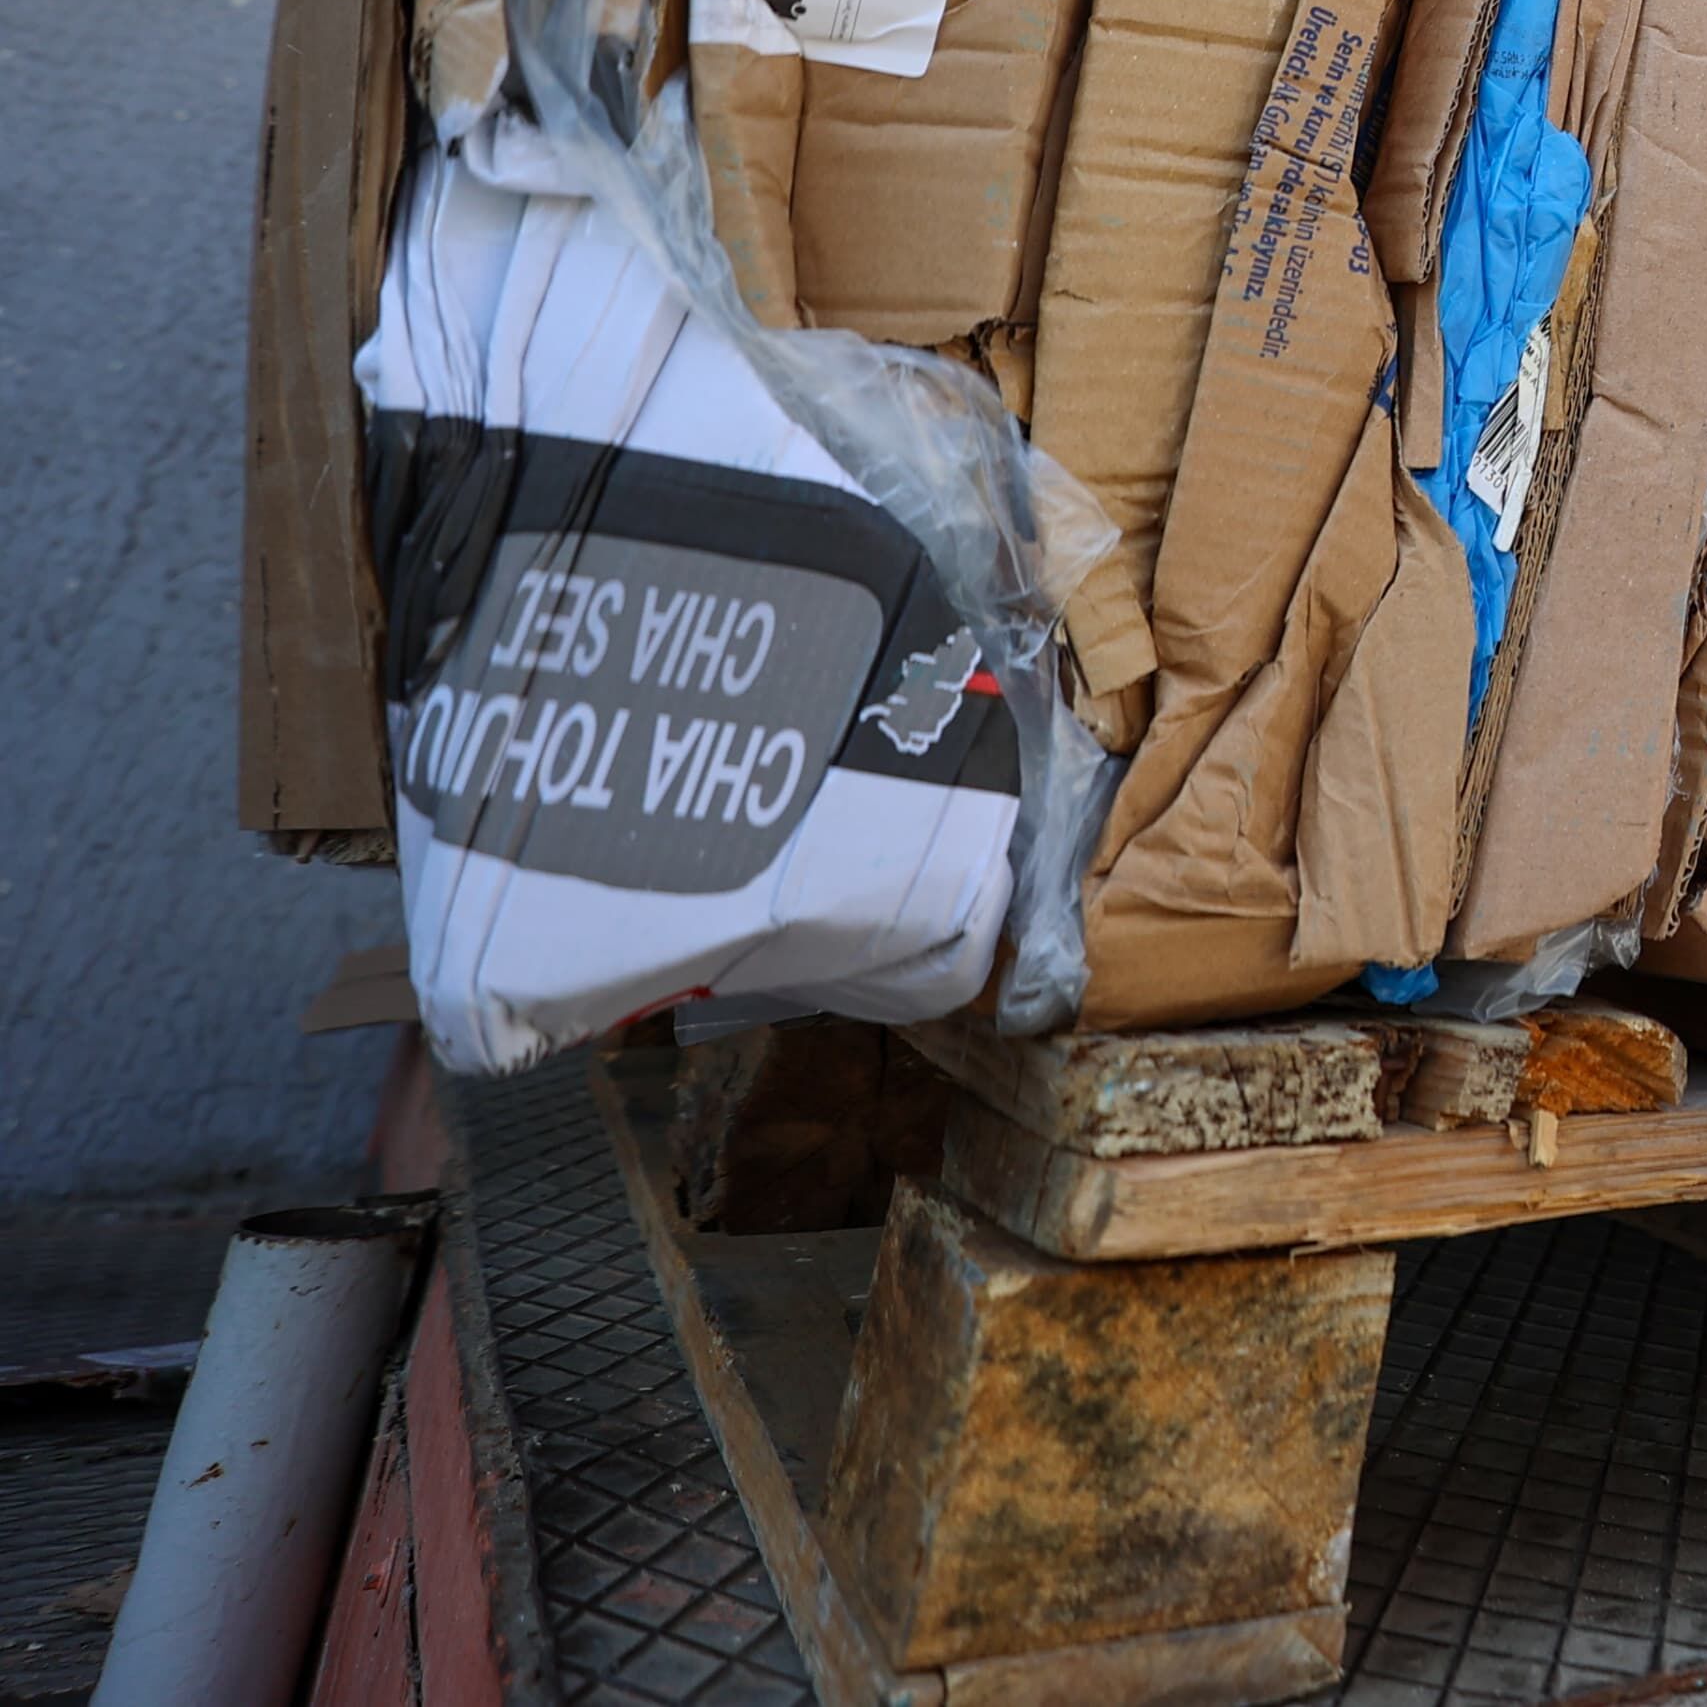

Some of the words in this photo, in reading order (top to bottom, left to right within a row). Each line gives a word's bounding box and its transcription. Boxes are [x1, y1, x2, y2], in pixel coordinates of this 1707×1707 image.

[1314, 83, 1339, 107] ve
[1325, 29, 1363, 82] Serin
[1293, 105, 1334, 155] kuru
[1259, 244, 1315, 359] üzerindedir.
[628, 584, 776, 697] CHIA
[643, 713, 806, 828] CHIA
